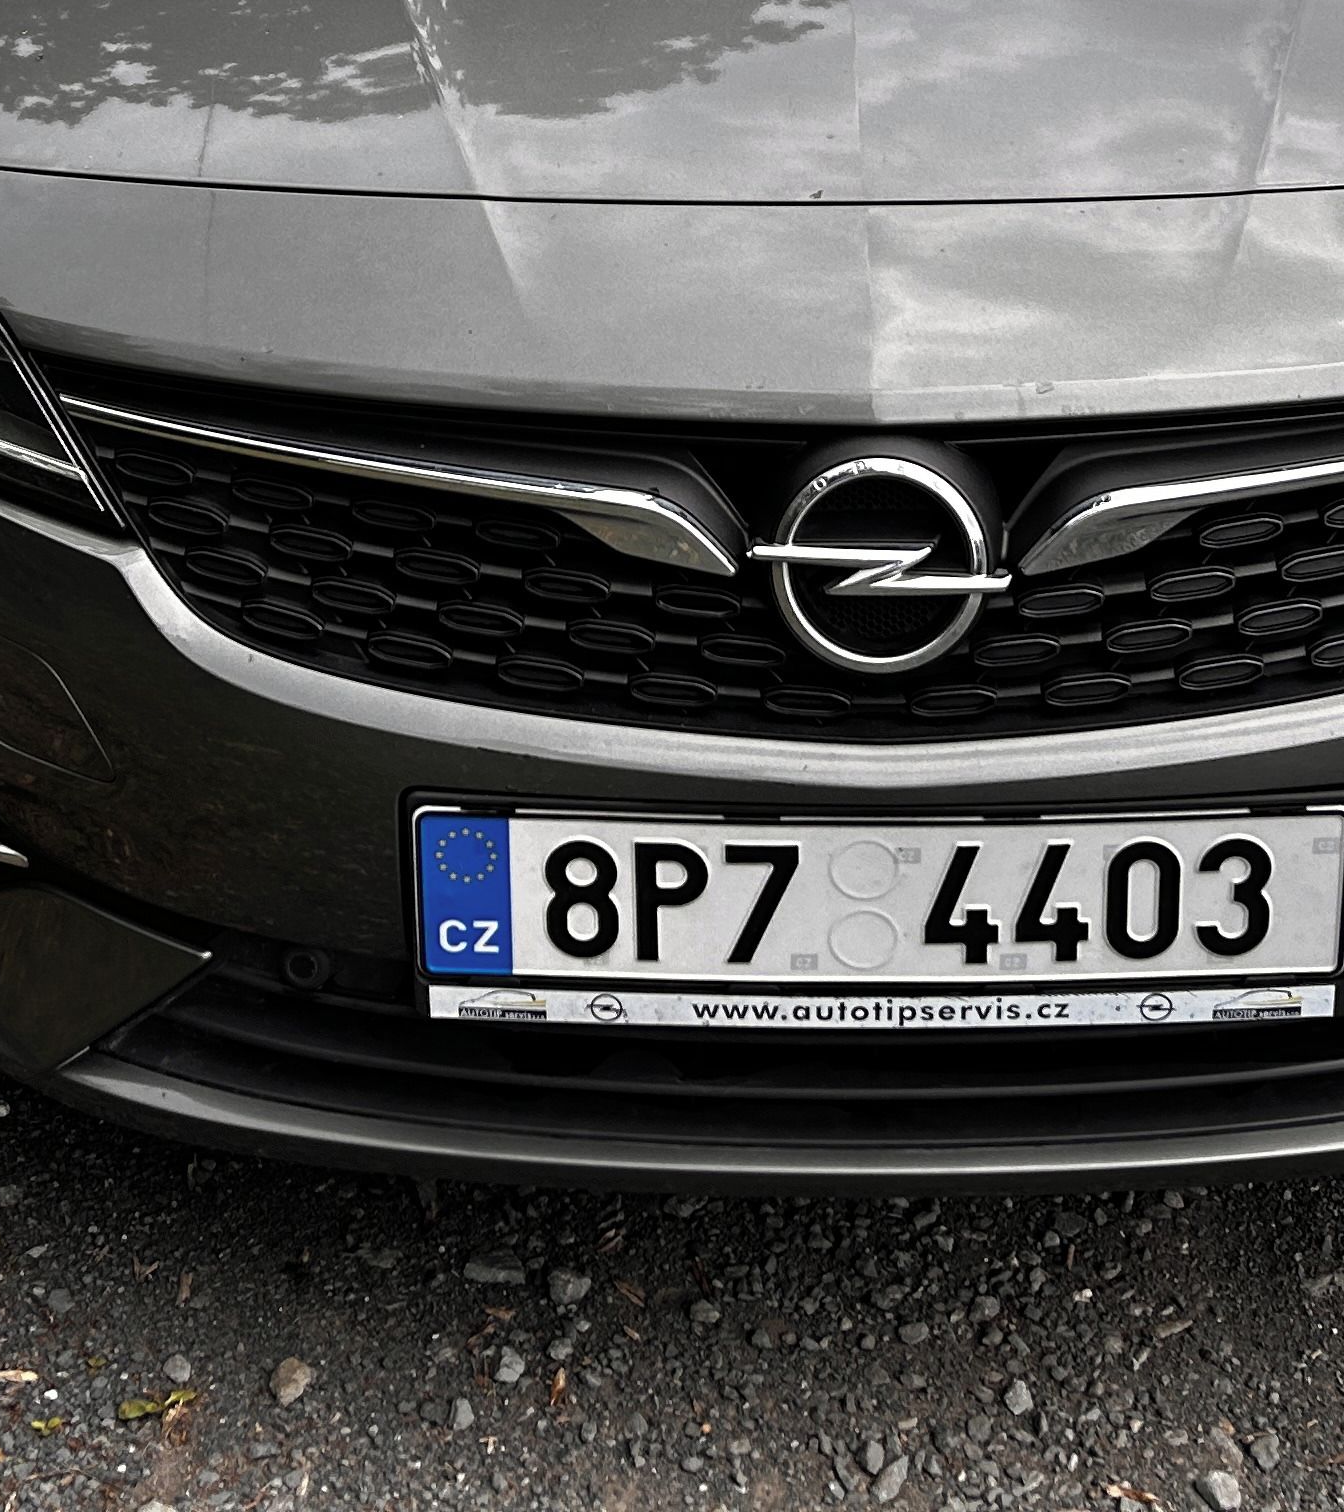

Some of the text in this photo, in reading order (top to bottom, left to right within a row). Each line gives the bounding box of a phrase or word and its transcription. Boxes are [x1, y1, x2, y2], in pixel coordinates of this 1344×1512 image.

[545, 839, 1271, 964] 8P7 4403
[440, 919, 499, 952] CZ
[693, 1002, 1069, 1026] www.autotipservis.cz
